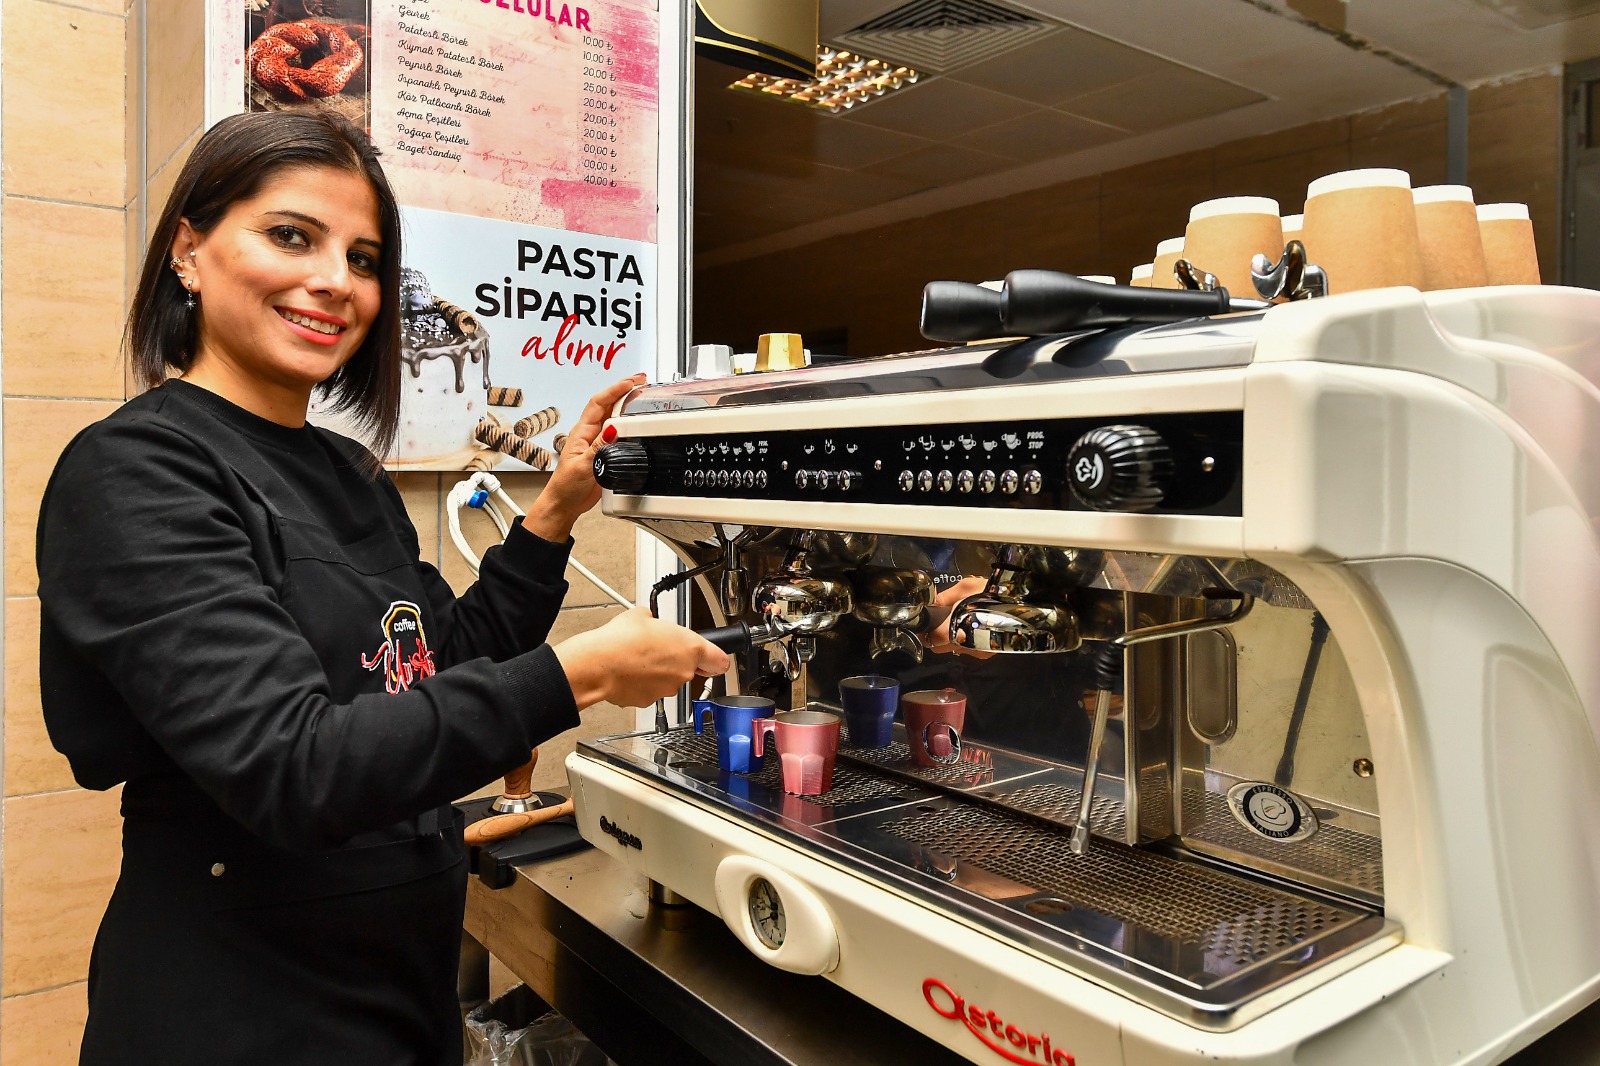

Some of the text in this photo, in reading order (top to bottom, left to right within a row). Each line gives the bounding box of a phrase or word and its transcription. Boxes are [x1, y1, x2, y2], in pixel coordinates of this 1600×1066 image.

[441, 33, 468, 46] Börek
[583, 36, 604, 48] 10,00
[398, 39, 434, 56] Kıymalı
[478, 57, 505, 71] Börek
[583, 51, 604, 64] 10,00
[435, 64, 463, 78] Börek
[583, 67, 607, 79] 20,00
[583, 82, 607, 94] 25,00
[398, 90, 491, 117] Köz Patlıcanlı Börek
[479, 90, 506, 104] Börek
[583, 98, 607, 110] 20,00
[397, 108, 423, 120] Açma
[584, 113, 607, 125] 20,00
[398, 124, 432, 139] Poğaça
[584, 129, 607, 141] 20,00
[397, 141, 462, 162] Baget Sandviç
[584, 175, 607, 187] 40,00
[518, 239, 644, 286] PASTA
[475, 276, 642, 338] SİPARİŞİ
[521, 313, 626, 370] alınır
[1027, 441, 1044, 450] STOP
[393, 618, 417, 633] coffee
[1252, 785, 1293, 804] ESPRESSO
[1251, 820, 1289, 838] ITALIANO
